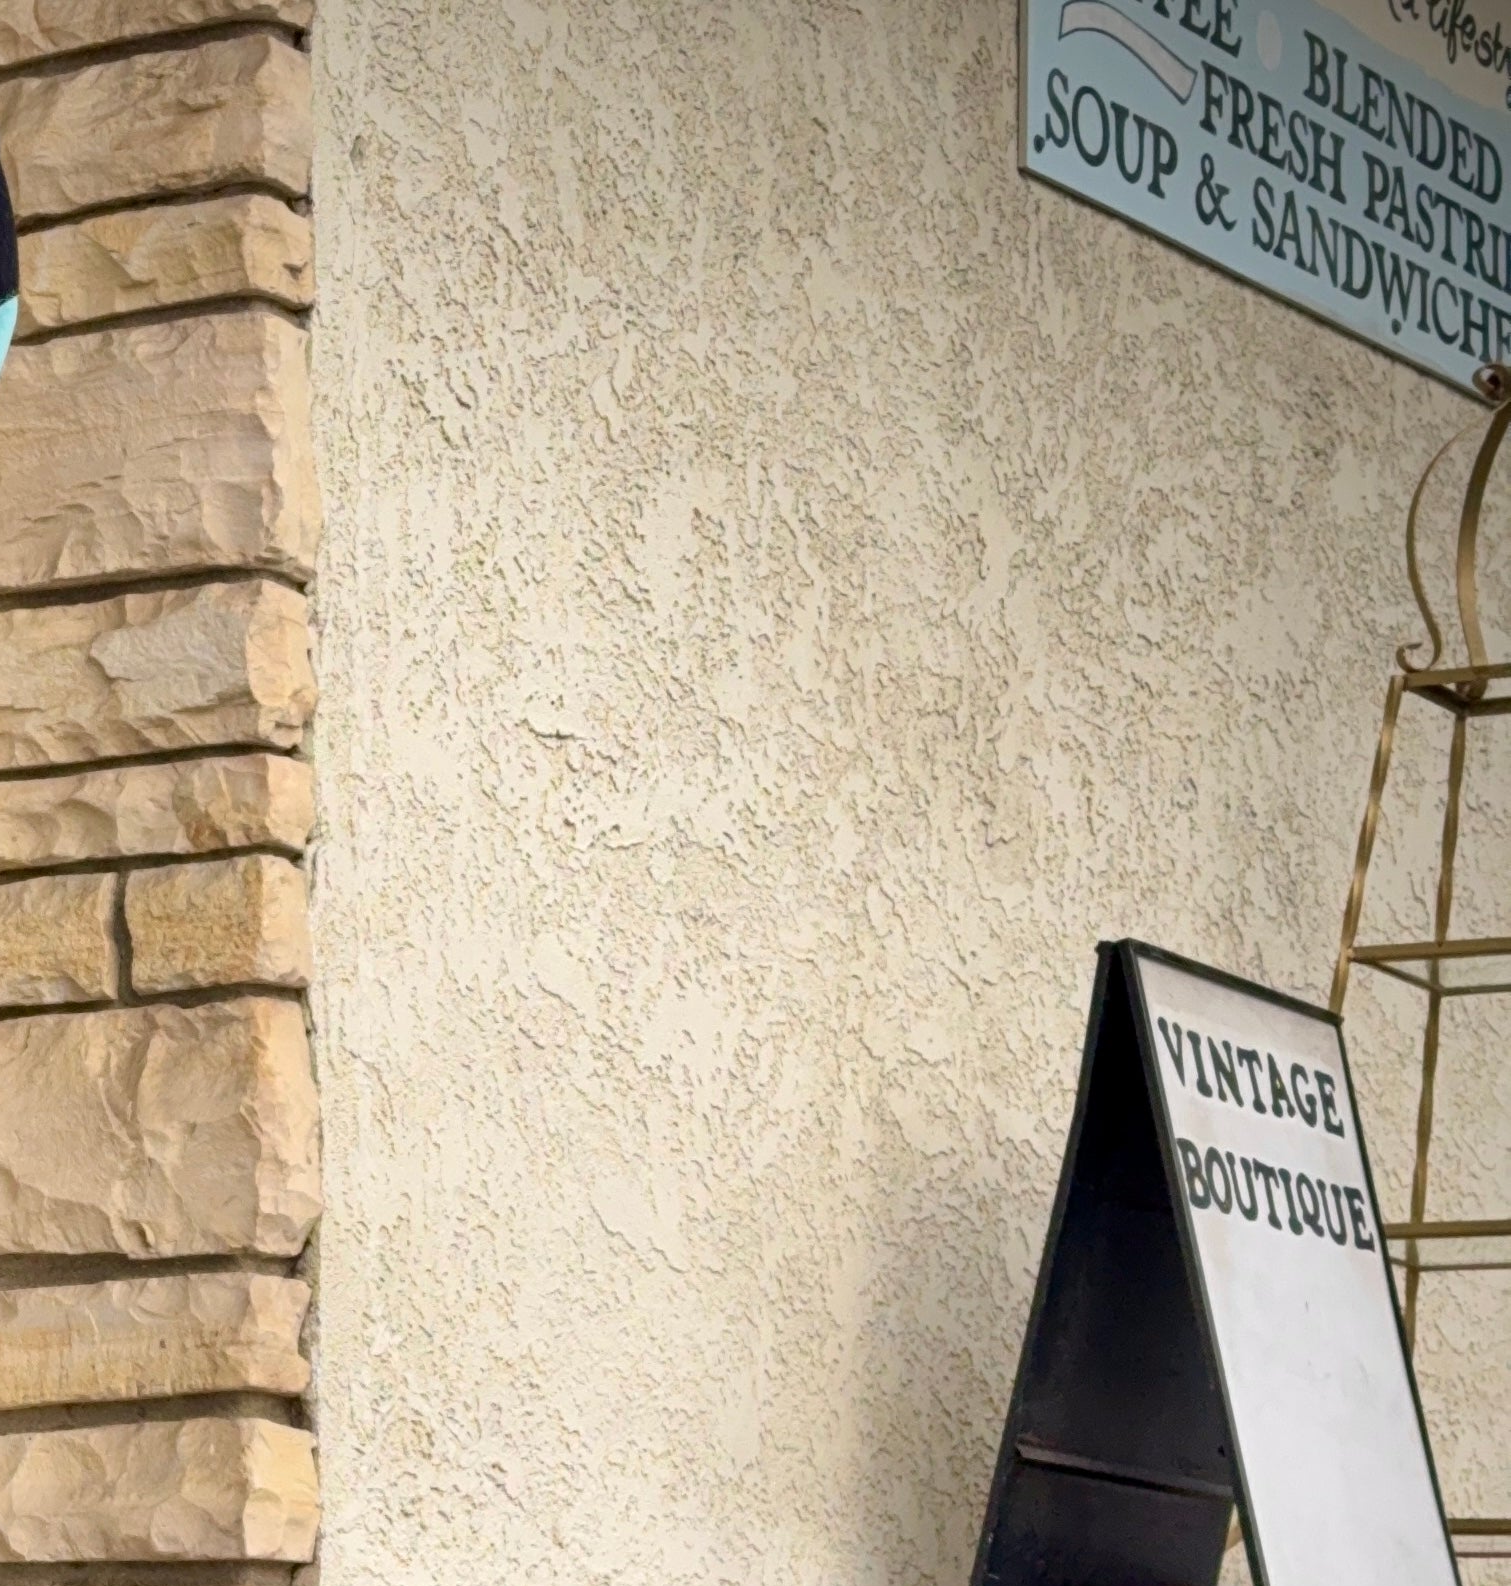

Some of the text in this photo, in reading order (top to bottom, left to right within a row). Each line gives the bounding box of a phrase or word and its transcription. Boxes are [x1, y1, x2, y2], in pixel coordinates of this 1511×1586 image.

[1045, 68, 1178, 199] SOUP
[1194, 153, 1237, 231] &
[1199, 60, 1348, 204] FRESH
[1303, 29, 1503, 204] BLENDED
[1157, 1016, 1345, 1138] VINTAGE
[1175, 1137, 1376, 1252] BOUTIQUE
